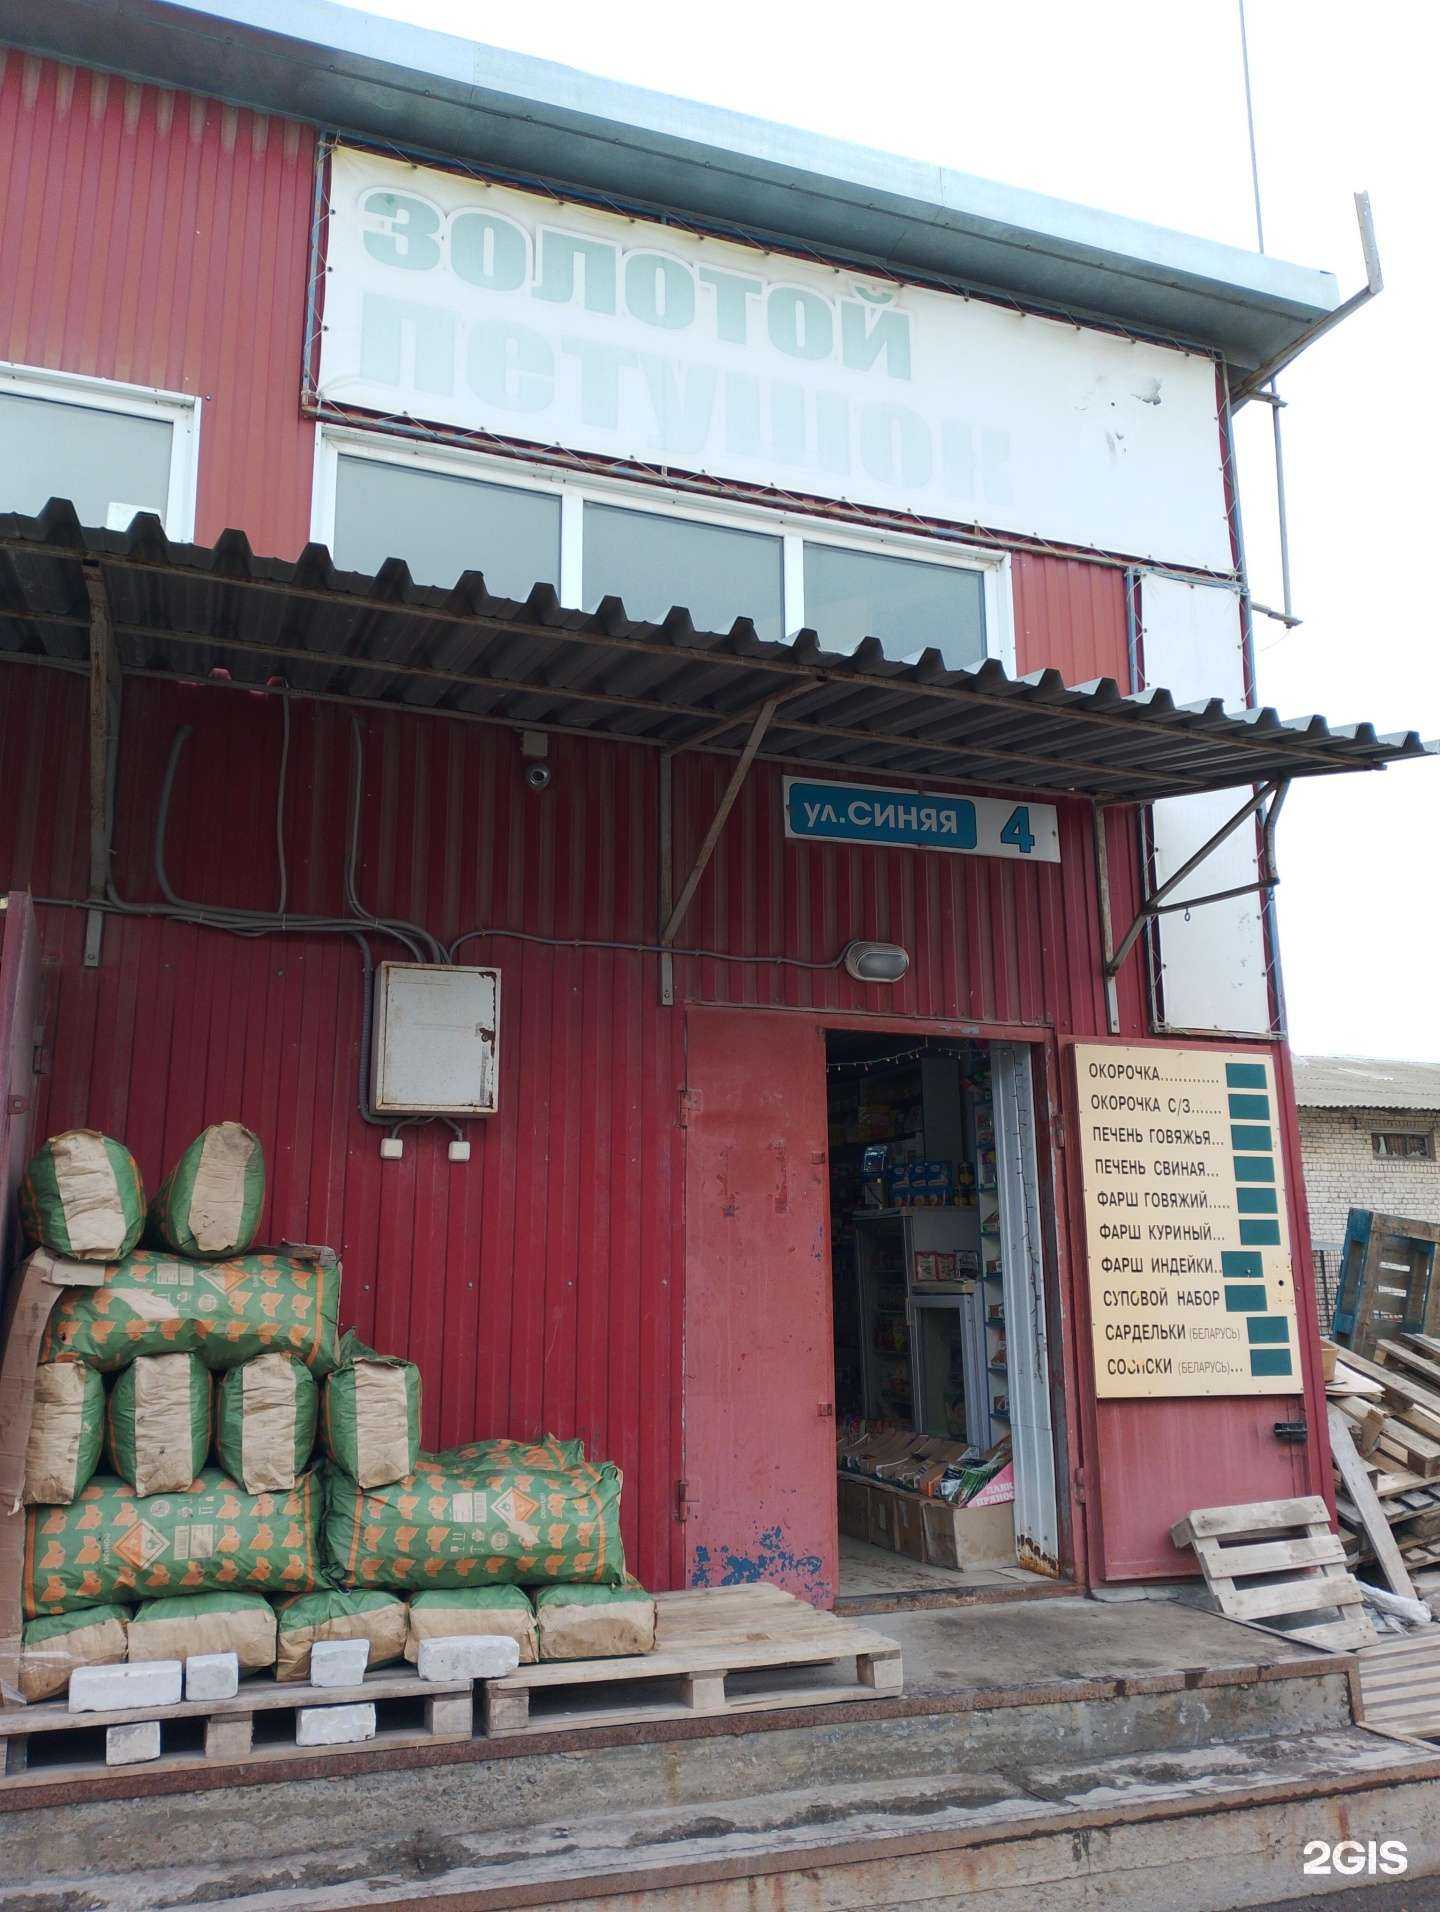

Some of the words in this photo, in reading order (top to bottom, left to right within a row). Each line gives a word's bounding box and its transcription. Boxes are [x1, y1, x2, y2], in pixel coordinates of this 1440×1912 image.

[803, 801, 958, 834] ул.СИНЯЯ
[1000, 806, 1035, 853] 4
[1091, 1094, 1161, 1112] ОКОРОЧКА
[1093, 1126, 1143, 1143] ПЕЧЕНЬ
[1095, 1158, 1146, 1175] ПЕЧЕНЬ
[1097, 1191, 1139, 1208] ФАРШ
[1099, 1223, 1141, 1240] ФАРШ
[1101, 1256, 1143, 1273] ФАРШ
[1103, 1287, 1169, 1306] СУПОВОЙ
[1177, 1290, 1220, 1306] НАБОР
[1105, 1324, 1186, 1343] САРДЕЛЬКИ
[1189, 1327, 1241, 1342] (БЕЛАРУСЬ)
